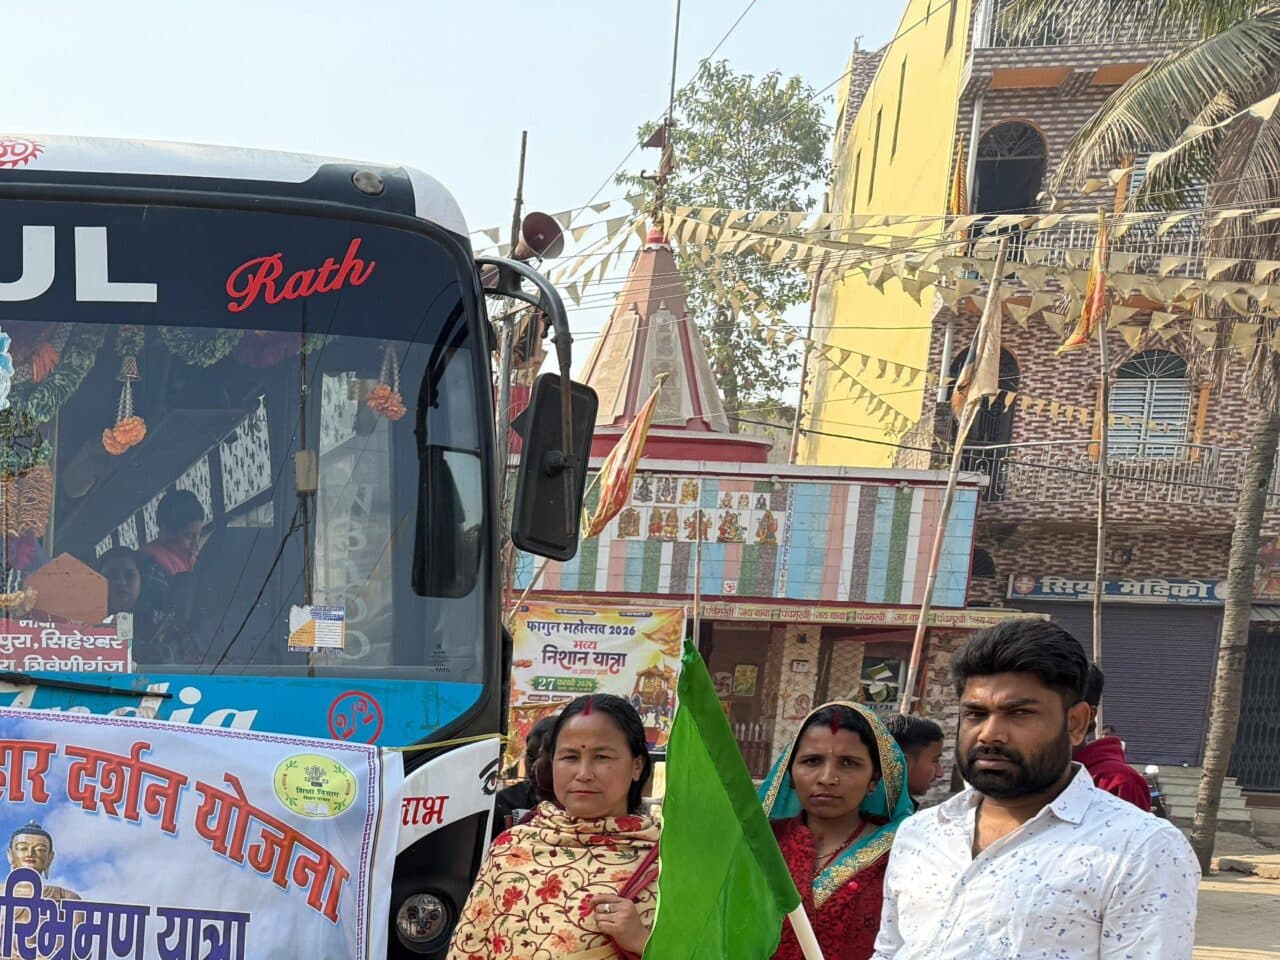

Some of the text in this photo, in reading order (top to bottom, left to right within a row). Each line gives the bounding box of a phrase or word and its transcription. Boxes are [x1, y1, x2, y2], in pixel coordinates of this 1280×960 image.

[226, 237, 376, 312] Rath
[1118, 578, 1211, 597] मेडिको
[527, 619, 635, 636] फागुन महोत्सव 2026
[573, 640, 599, 650] भव्य
[541, 644, 627, 674] निशान यात्रा
[537, 678, 556, 690] 27
[64, 741, 188, 835] दर्शन
[194, 772, 351, 925] योजना
